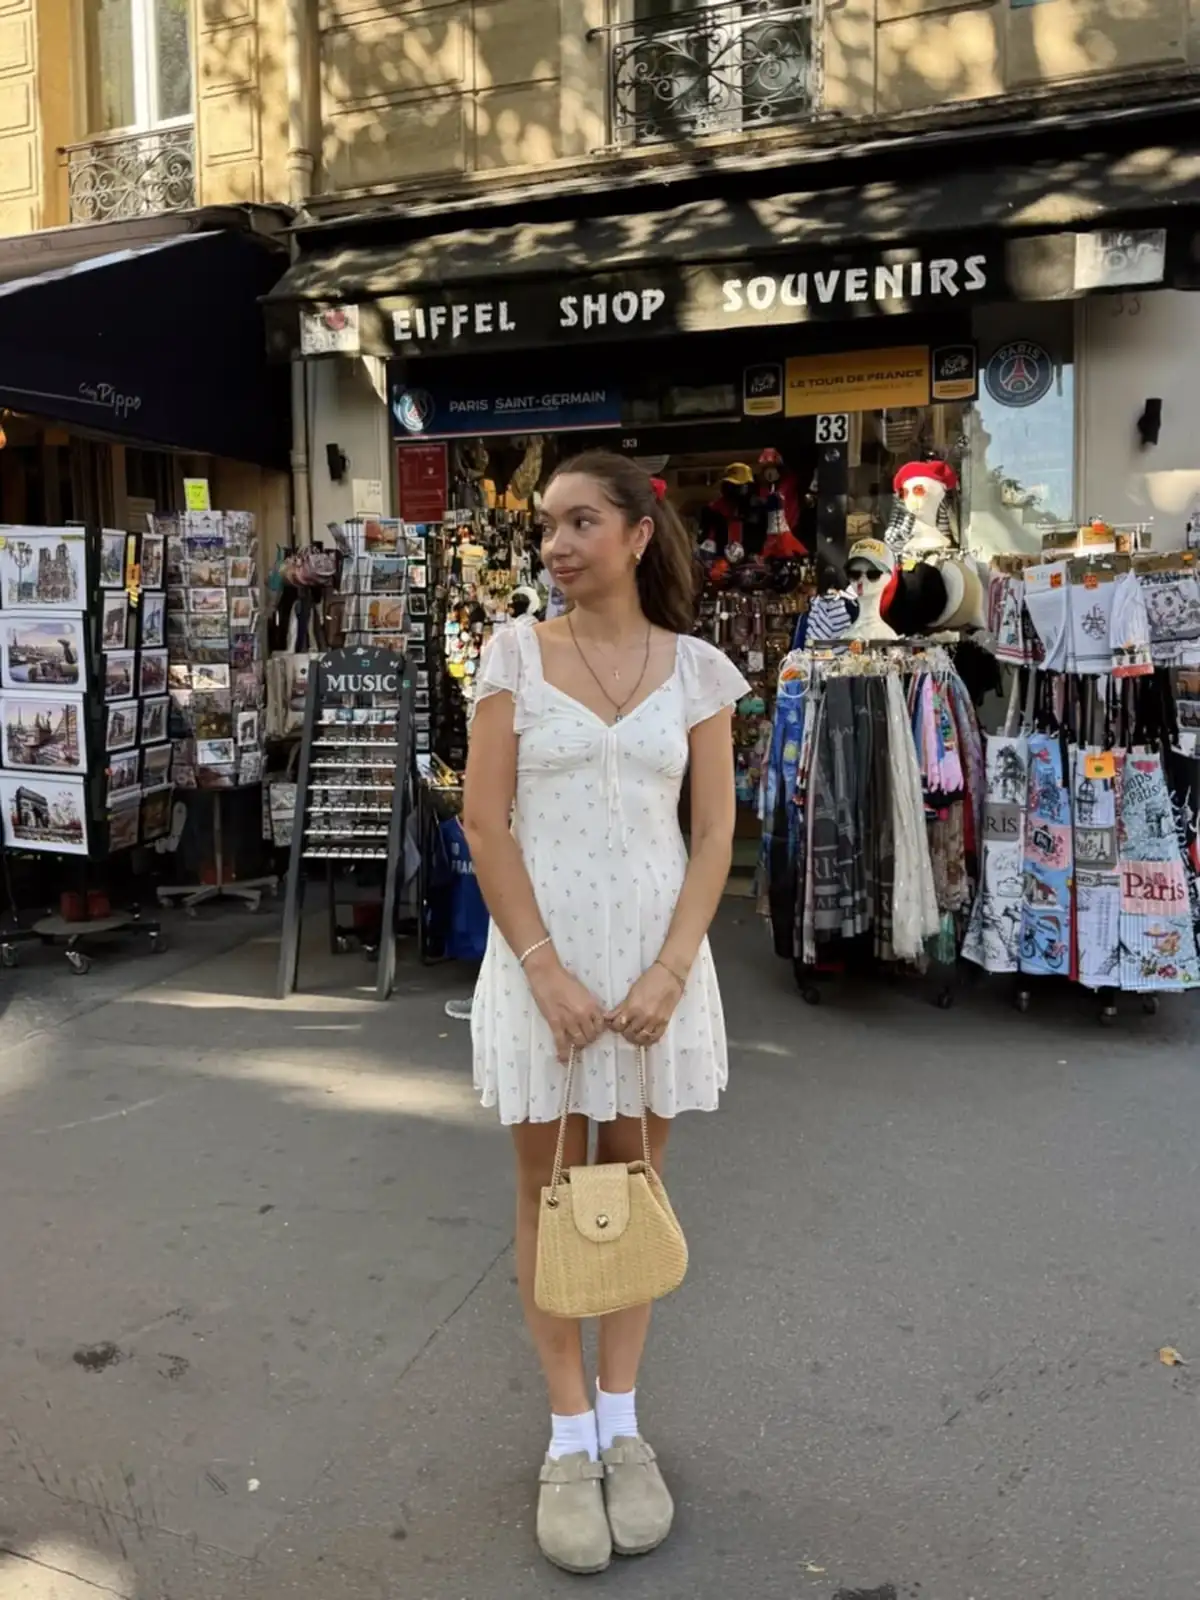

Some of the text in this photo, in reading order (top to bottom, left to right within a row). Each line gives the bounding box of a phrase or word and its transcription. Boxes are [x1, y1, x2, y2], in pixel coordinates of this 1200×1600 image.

[392, 254, 988, 341] EIFFEL SHOP SOUVENIRS
[808, 376, 845, 388] TOUR
[846, 374, 865, 384] DE
[867, 367, 924, 381] FRANCE
[449, 389, 606, 413] PARIS SAINT-GERMAIN
[818, 415, 847, 442] 33
[326, 674, 397, 692] MUSIC
[1123, 872, 1185, 901] Paris
